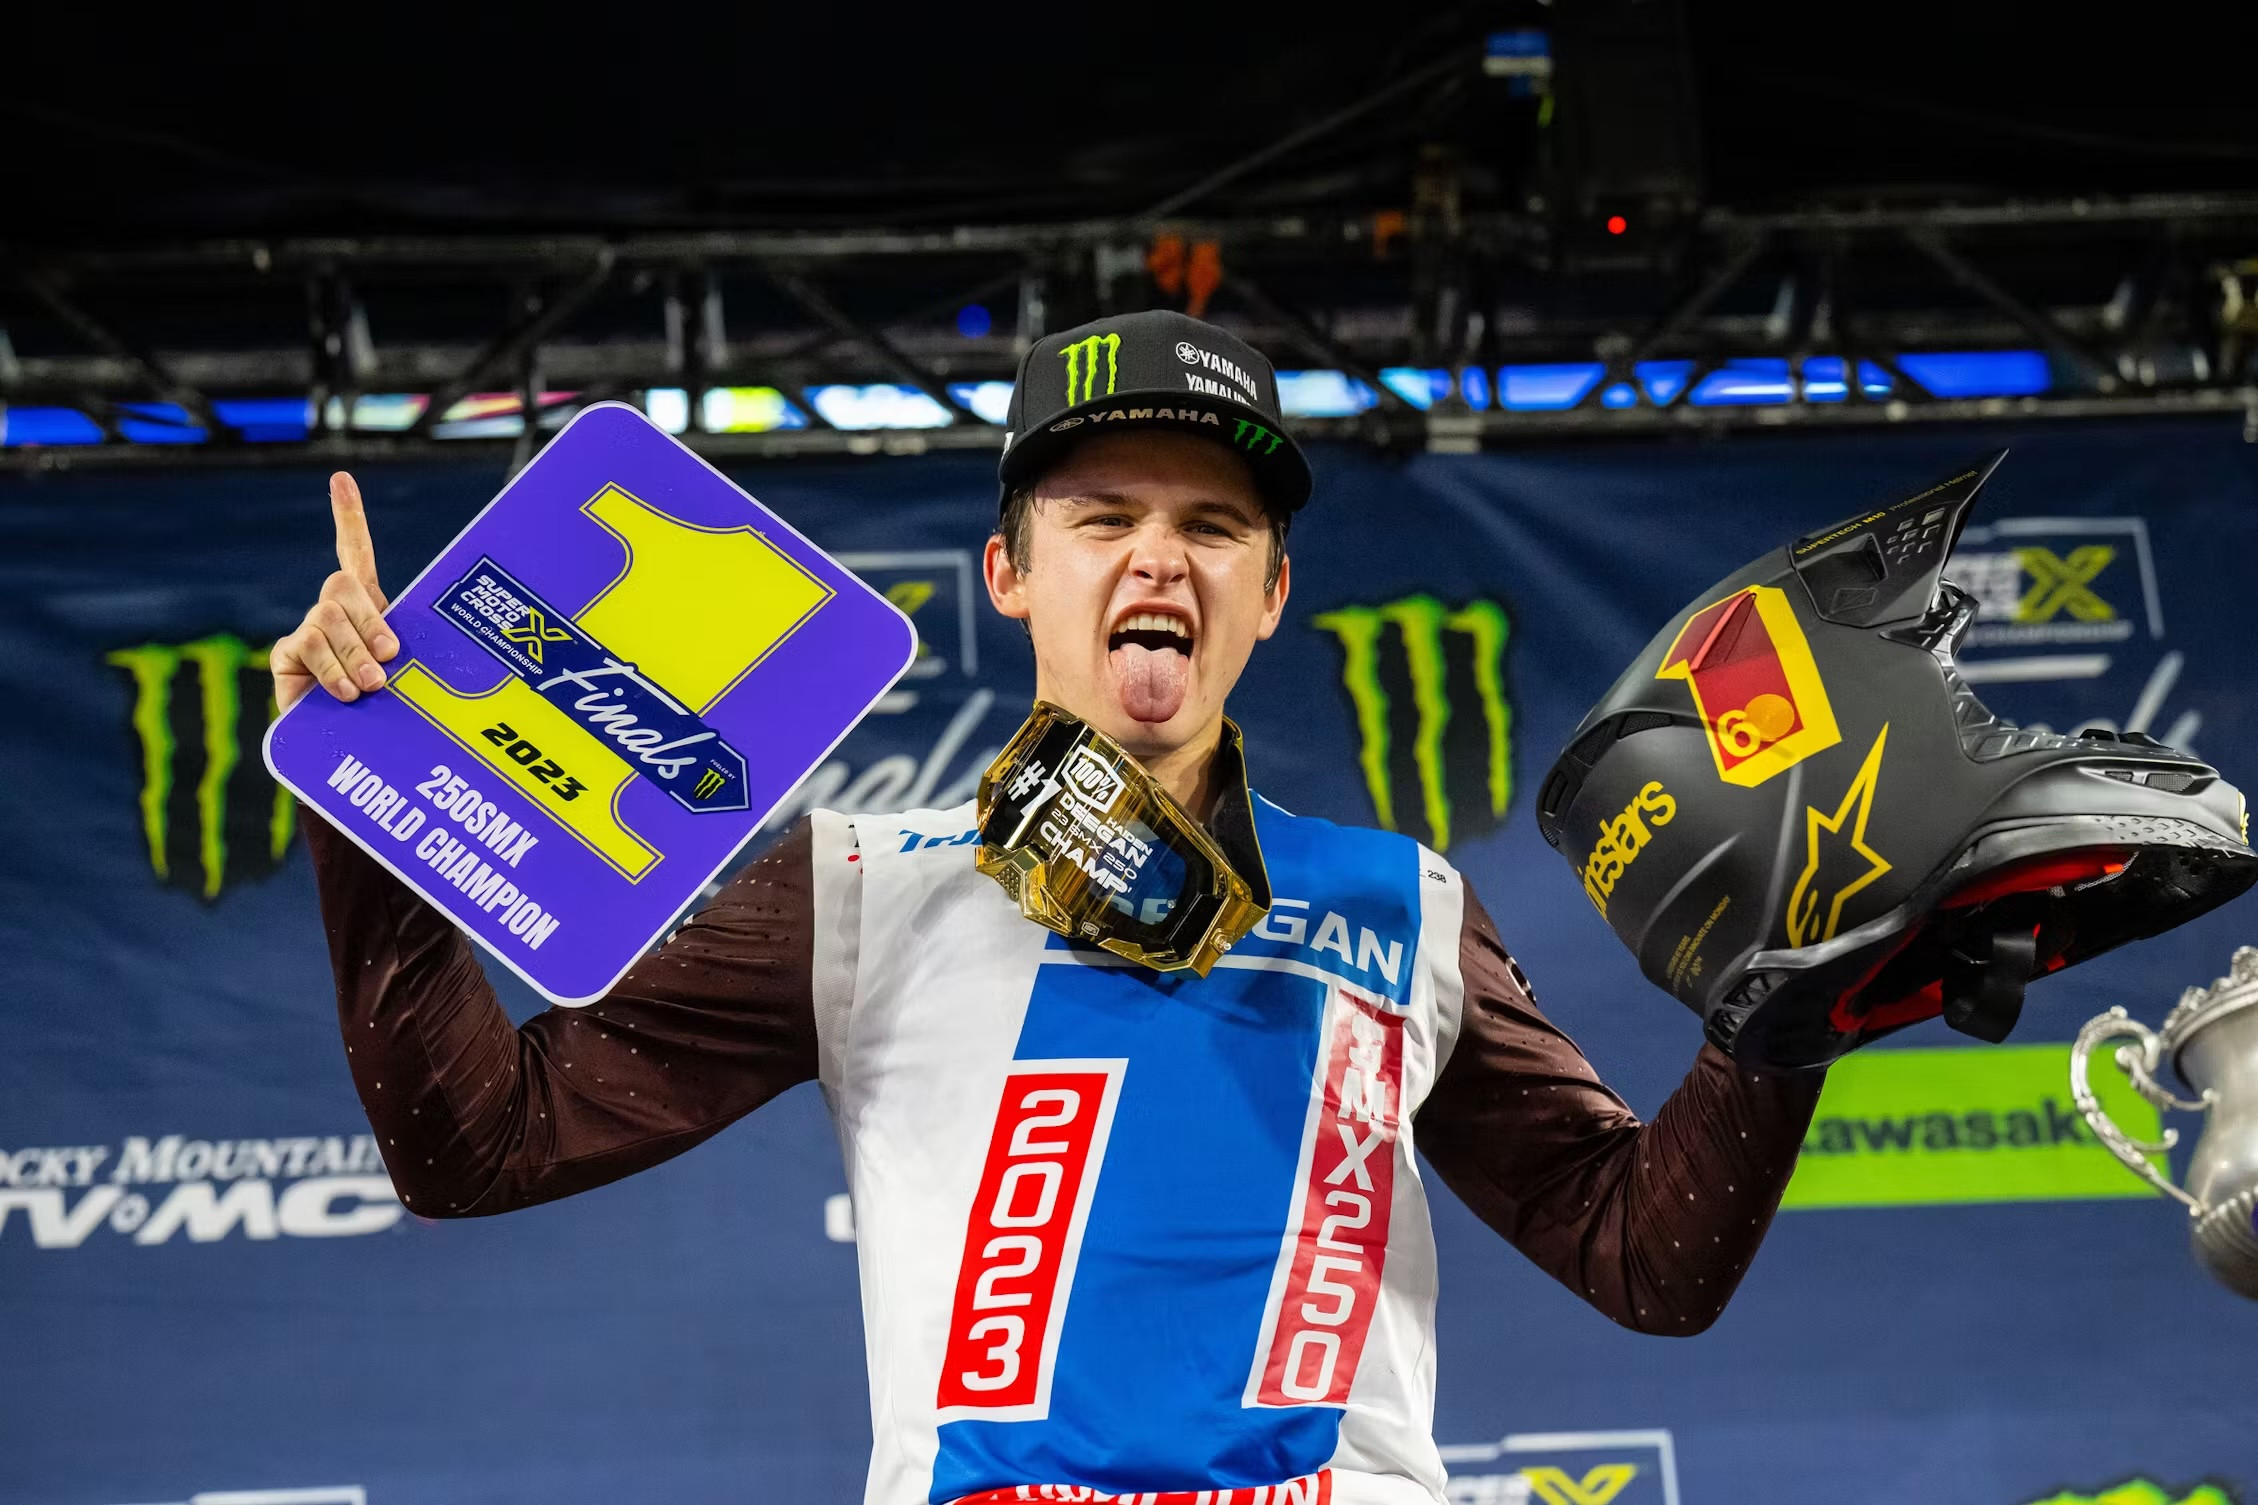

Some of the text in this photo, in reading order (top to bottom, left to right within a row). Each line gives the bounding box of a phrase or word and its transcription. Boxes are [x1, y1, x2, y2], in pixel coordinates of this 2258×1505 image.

[1198, 349, 1258, 401] YAMAHA
[1088, 408, 1220, 426] YAMAHA
[1795, 522, 1863, 555] SUPERTECH
[460, 590, 515, 632] CROSS
[470, 585, 521, 624] MOTO
[475, 574, 531, 618] SUPER
[450, 602, 544, 676] WORLD CHAMPIONSHIP
[536, 657, 717, 780] Finals
[480, 722, 590, 802] 2023
[1069, 756, 1116, 802] 100%
[415, 764, 540, 869] 250SMX
[1058, 792, 1149, 870] DEEGAN
[1105, 816, 1154, 858] HAIDEN
[326, 753, 561, 951] WORLD CHAMPION
[1050, 807, 1139, 881] 23 SMX 250
[1427, 869, 1448, 884] 238
[961, 1088, 1081, 1391] 2023
